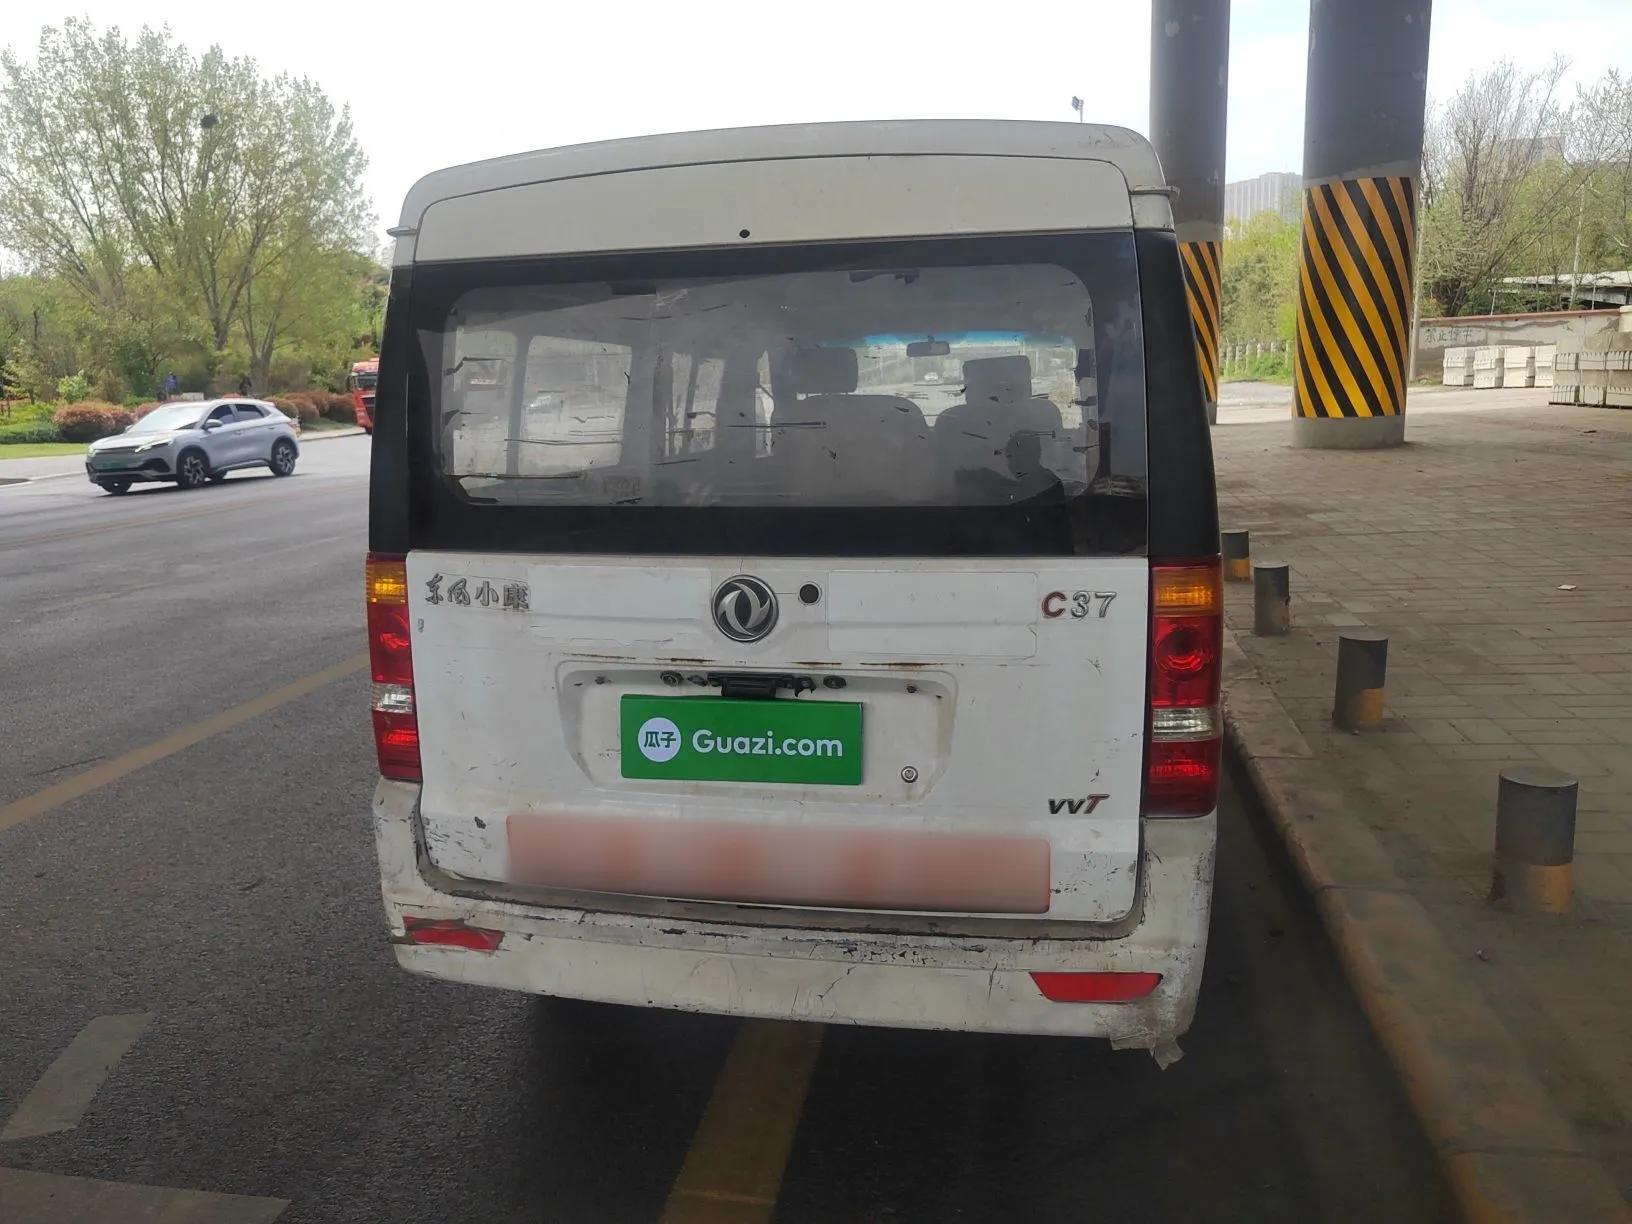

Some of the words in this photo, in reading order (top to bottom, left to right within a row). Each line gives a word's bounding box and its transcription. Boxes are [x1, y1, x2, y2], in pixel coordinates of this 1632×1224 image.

[425, 573, 530, 609] 东风小康
[1041, 591, 1118, 618] C37
[643, 731, 677, 749] 瓜子
[692, 729, 843, 757] Guazi.com
